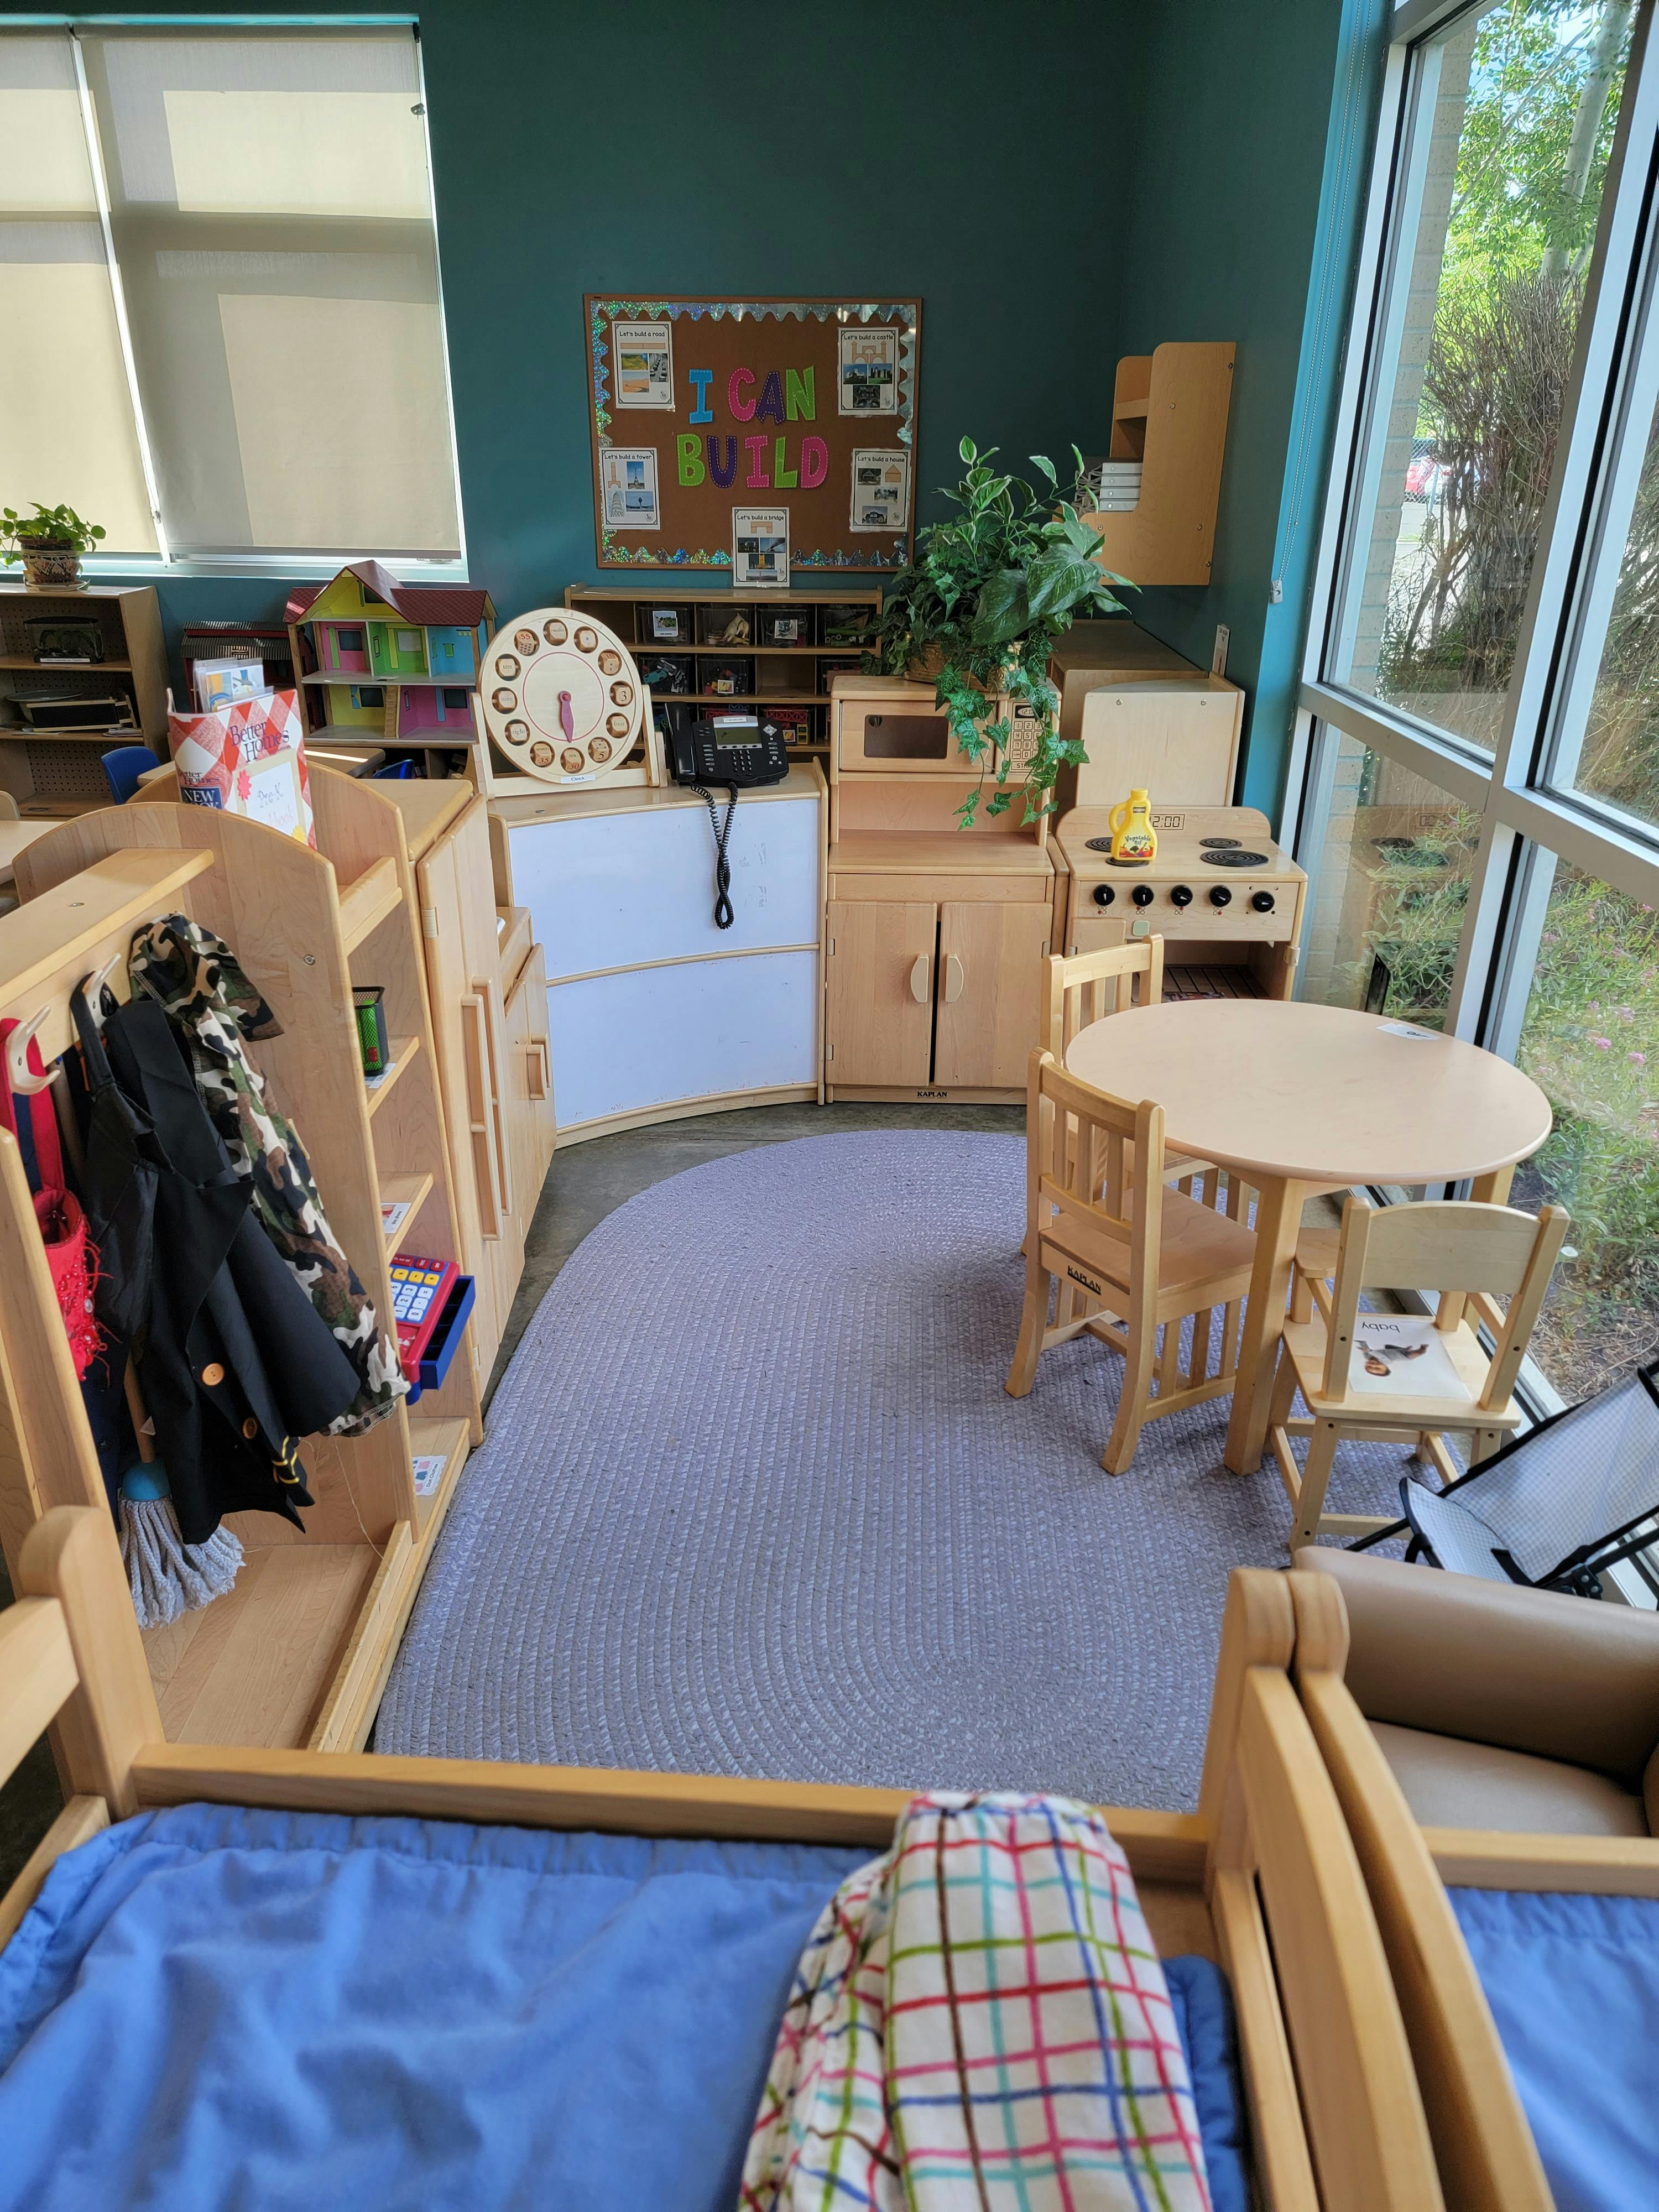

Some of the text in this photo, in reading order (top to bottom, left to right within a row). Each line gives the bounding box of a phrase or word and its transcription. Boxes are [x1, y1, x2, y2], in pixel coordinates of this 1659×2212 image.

[689, 365, 816, 424] I CAN
[676, 433, 828, 489] BUILD
[622, 691, 627, 701] 3
[229, 721, 267, 746] Better
[244, 730, 289, 763] Homes
[183, 790, 215, 802] NEW
[1067, 1265, 1102, 1292] KAPLAN
[1362, 1321, 1401, 1333] baby
